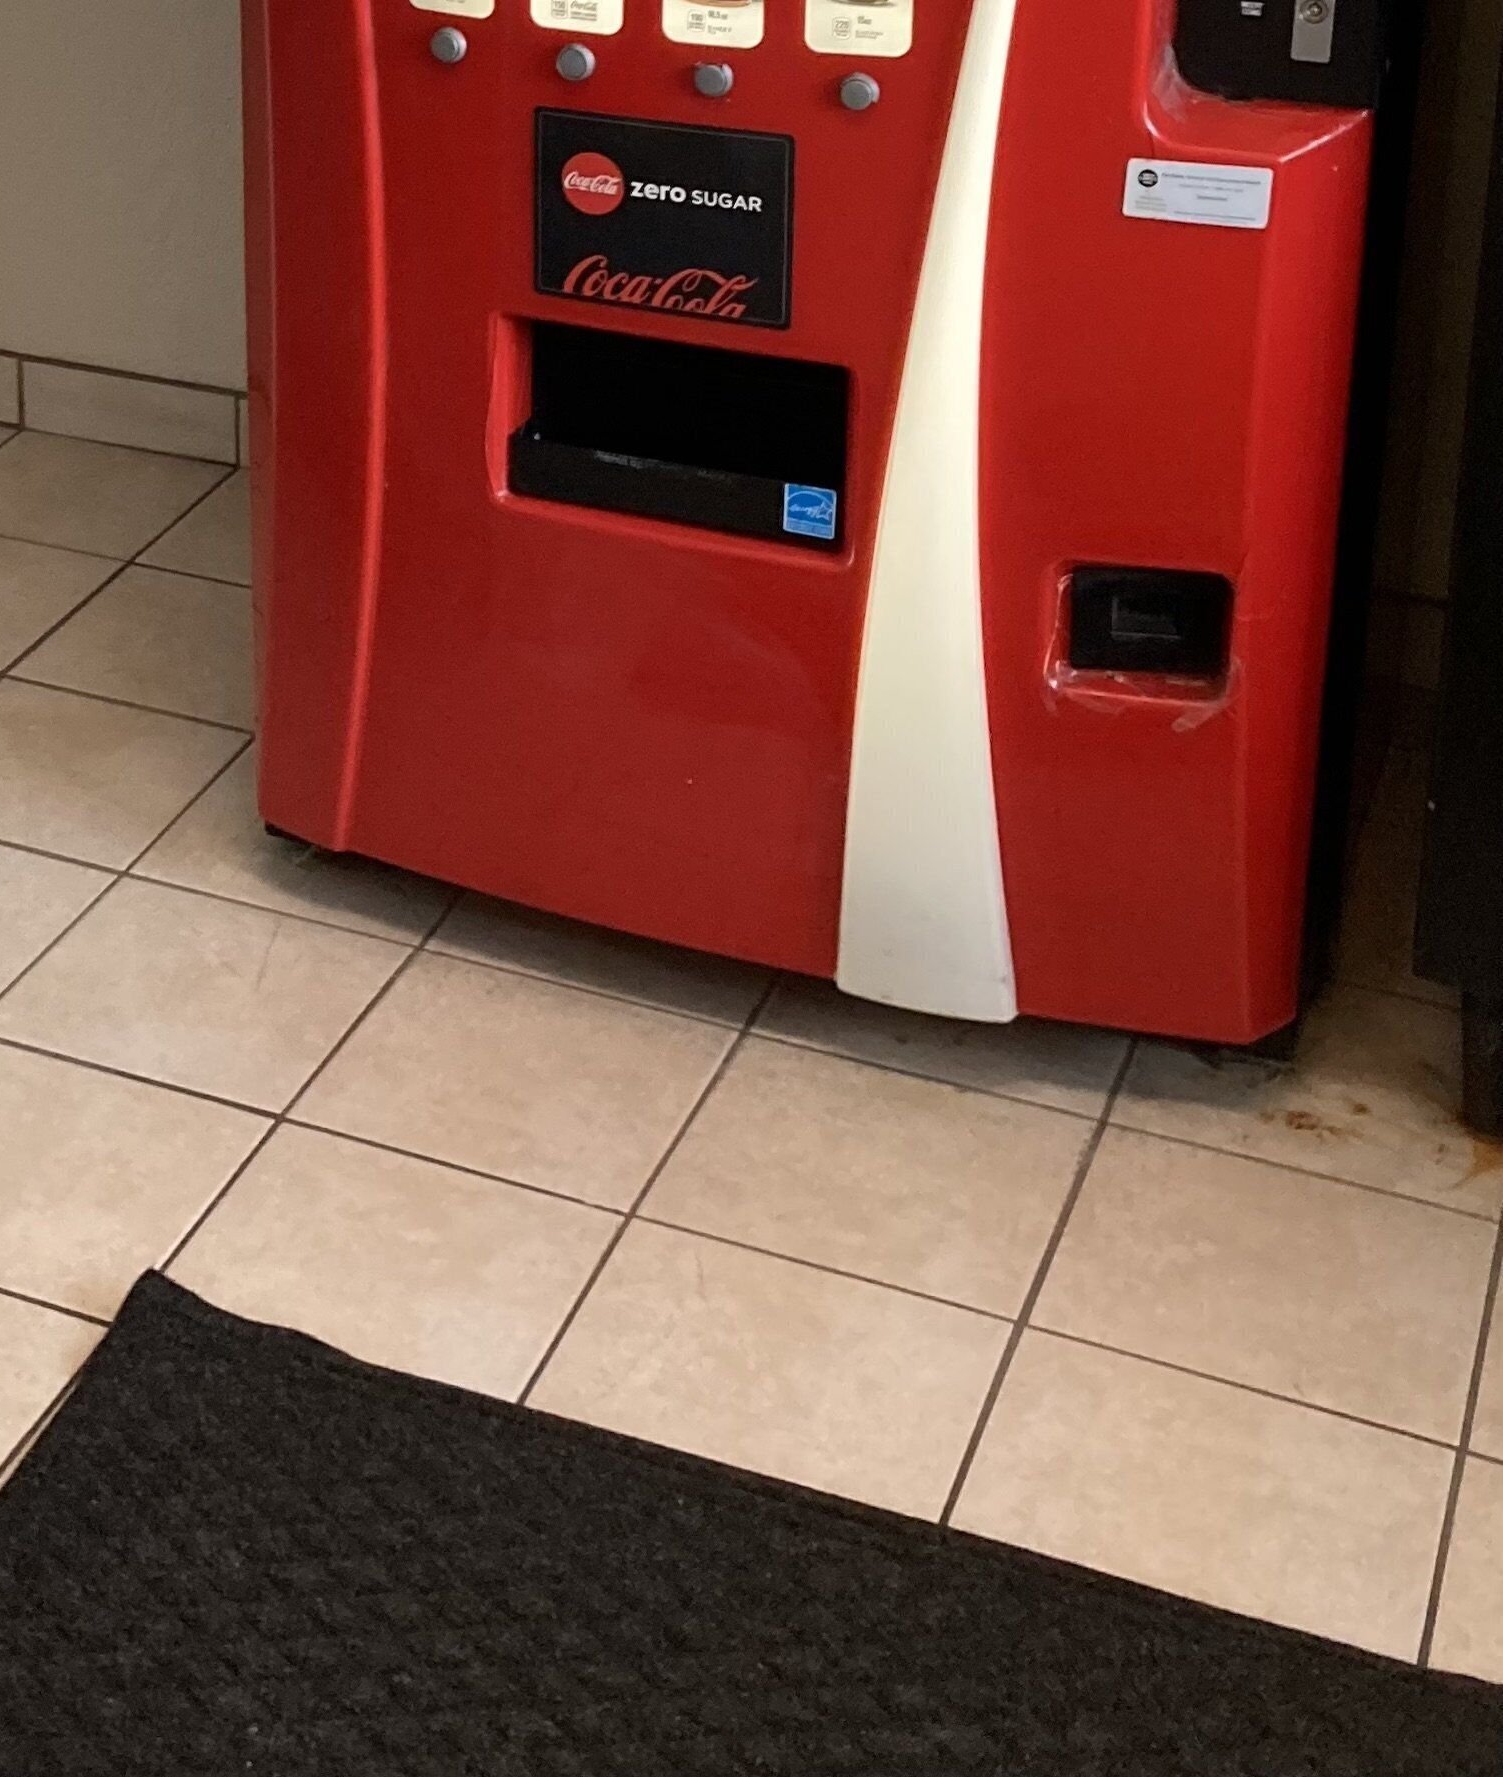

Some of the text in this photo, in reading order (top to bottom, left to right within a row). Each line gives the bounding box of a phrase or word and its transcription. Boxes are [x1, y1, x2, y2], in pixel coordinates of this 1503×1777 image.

[564, 171, 762, 212] Coca-Cola zero SUGAR
